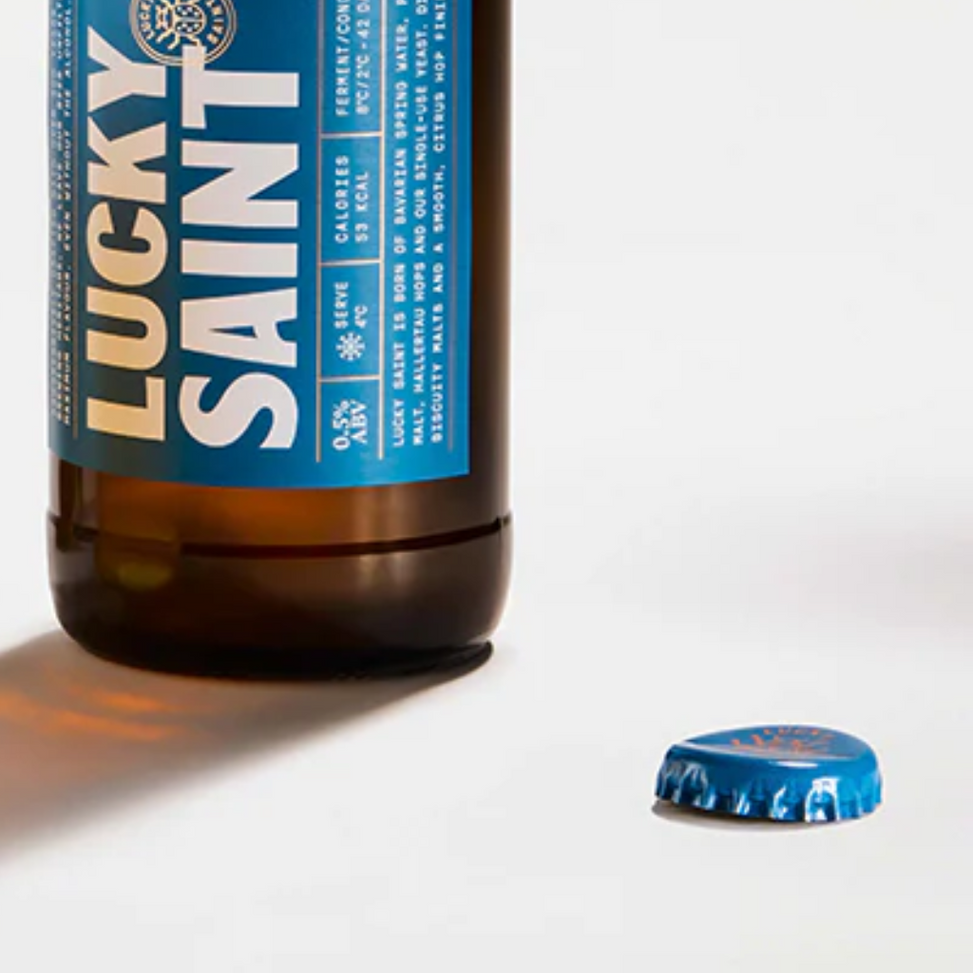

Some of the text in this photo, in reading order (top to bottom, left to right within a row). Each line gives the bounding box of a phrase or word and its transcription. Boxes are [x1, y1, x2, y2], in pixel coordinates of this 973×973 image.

[433, 51, 446, 83] HOP
[393, 81, 408, 139] SPRING
[414, 86, 428, 181] SINGLE-USE
[433, 92, 446, 152] CITRUS
[335, 155, 349, 243] CALORIES
[355, 171, 369, 242] 53 KCAL
[393, 149, 407, 224] BAVARIAN
[414, 189, 427, 218] OUR
[87, 25, 168, 441] LUCKY
[178, 45, 299, 449] SAINT
[393, 235, 406, 254] OF
[414, 224, 426, 253] AND
[432, 243, 444, 253] A
[393, 264, 406, 303] BORN
[413, 262, 426, 302] HOPS
[432, 263, 444, 293] AND
[334, 282, 349, 329] SERVE
[355, 305, 368, 328] 4°C
[393, 312, 406, 331] IS
[432, 303, 444, 353] MALTS
[393, 342, 405, 390] SAINT
[413, 308, 426, 393] HALLERTAU
[332, 399, 351, 451] 0.5%
[350, 399, 367, 444] ABV
[392, 399, 405, 447] LUCKY
[413, 401, 426, 446] MALT,
[431, 363, 443, 443] BISCUITY
